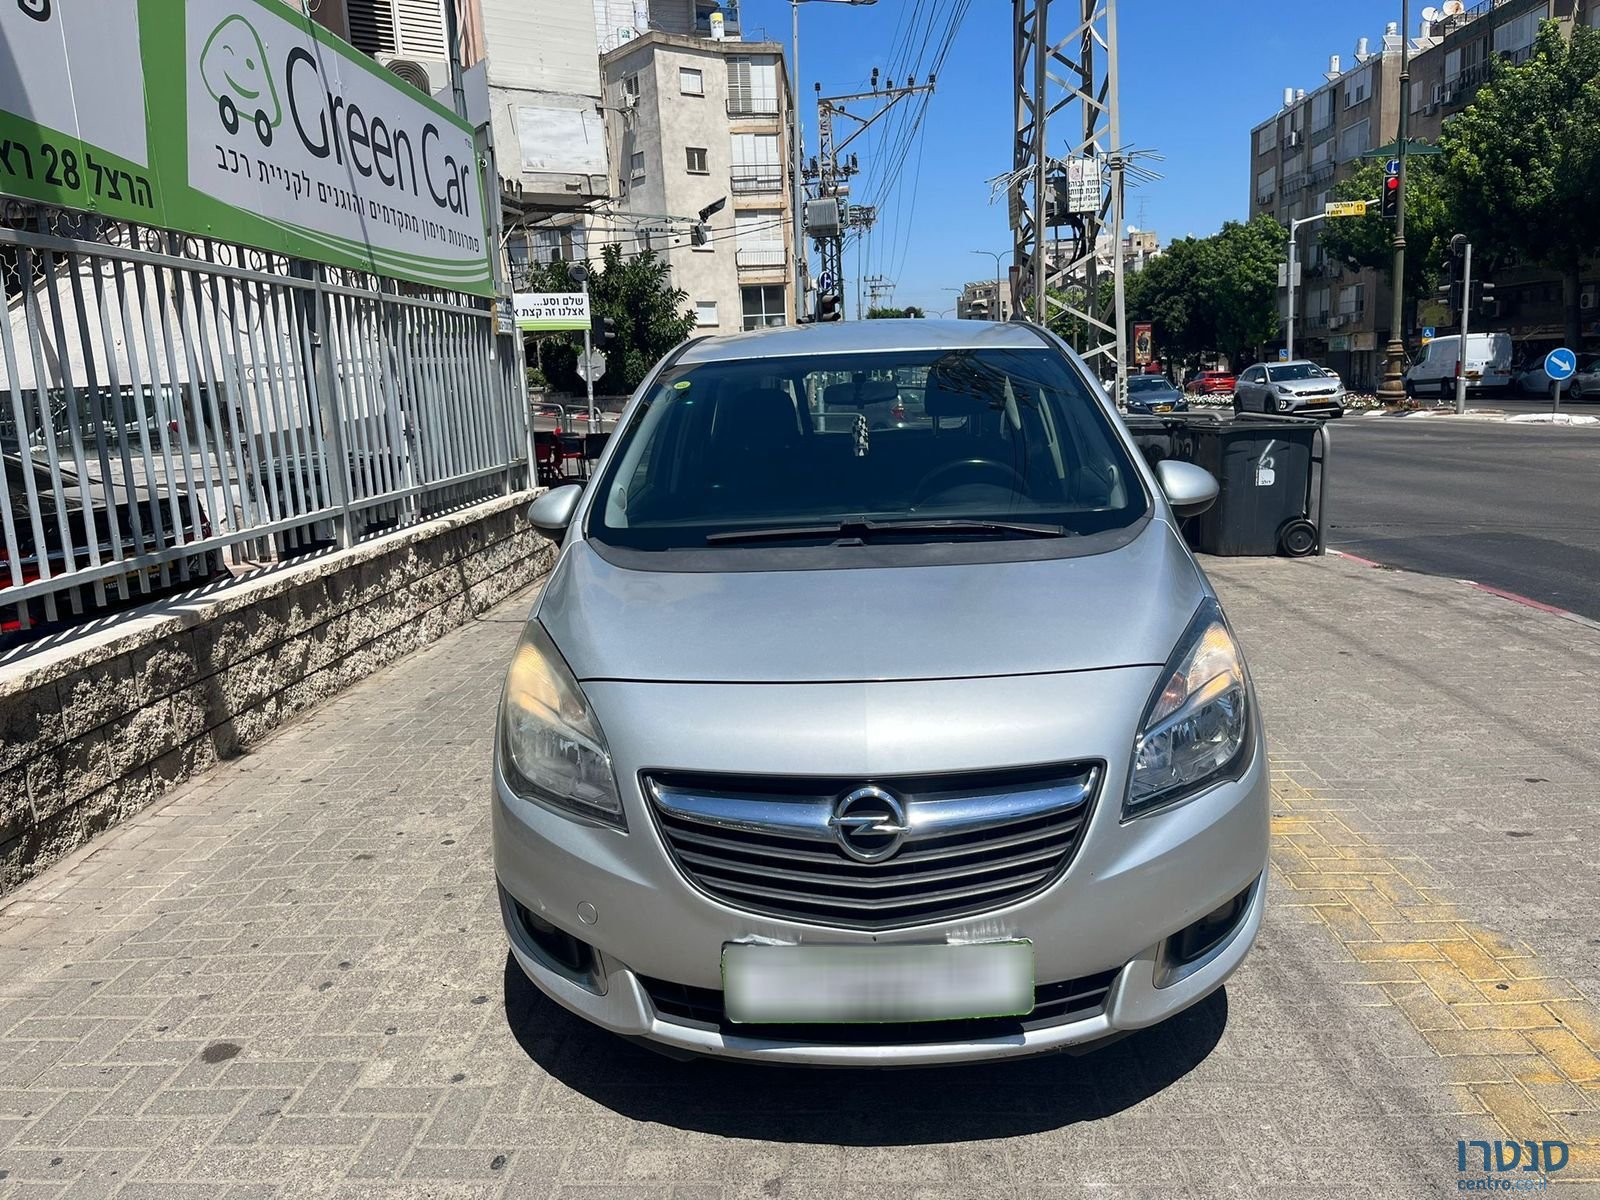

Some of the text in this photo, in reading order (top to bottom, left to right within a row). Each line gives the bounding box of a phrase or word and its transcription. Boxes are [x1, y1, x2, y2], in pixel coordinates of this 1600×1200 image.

[285, 46, 469, 218] Green Car
[40, 143, 81, 190] 28
[86, 152, 154, 209] הרצל
[215, 144, 480, 253] פתרונות מימון מתקדמים והוגנים לקניית רכב
[522, 308, 542, 318] קצת
[533, 296, 584, 306] שלם וסע...
[545, 308, 556, 317] זה
[559, 306, 585, 317] אצלנו
